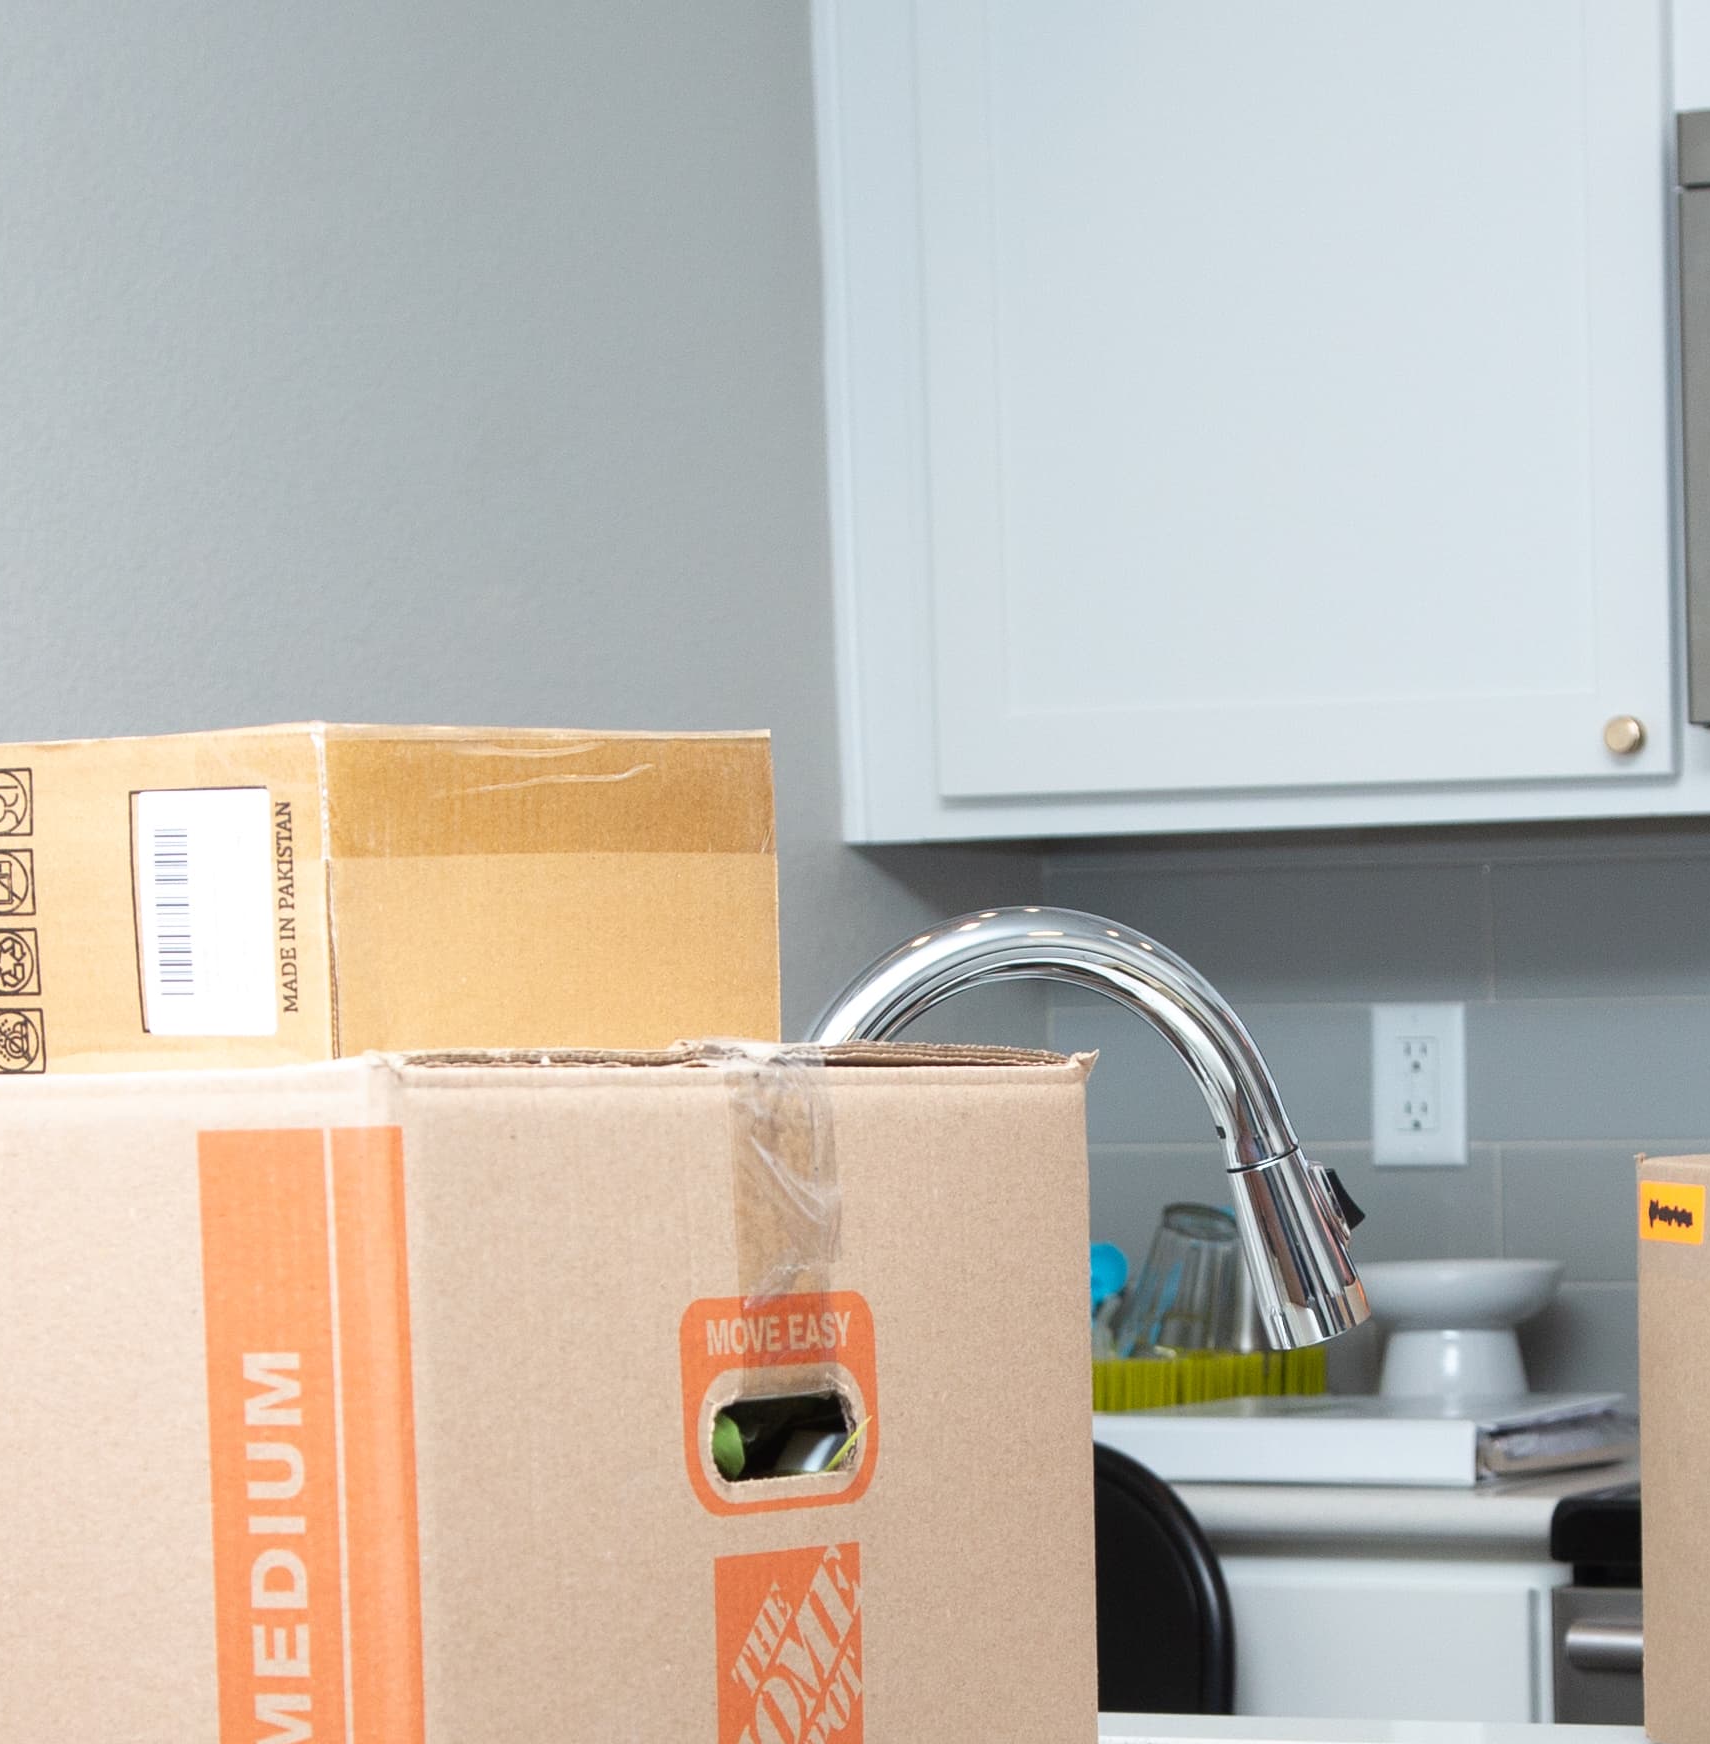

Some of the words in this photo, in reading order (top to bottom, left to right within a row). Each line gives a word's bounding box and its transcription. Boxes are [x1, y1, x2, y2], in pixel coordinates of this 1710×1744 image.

[275, 801, 295, 910] PAKISTAN
[279, 918, 295, 940] IN
[281, 948, 298, 1013] MADE
[706, 1316, 783, 1356] MOVE
[788, 1311, 852, 1350] EASY
[731, 1581, 793, 1698] THE
